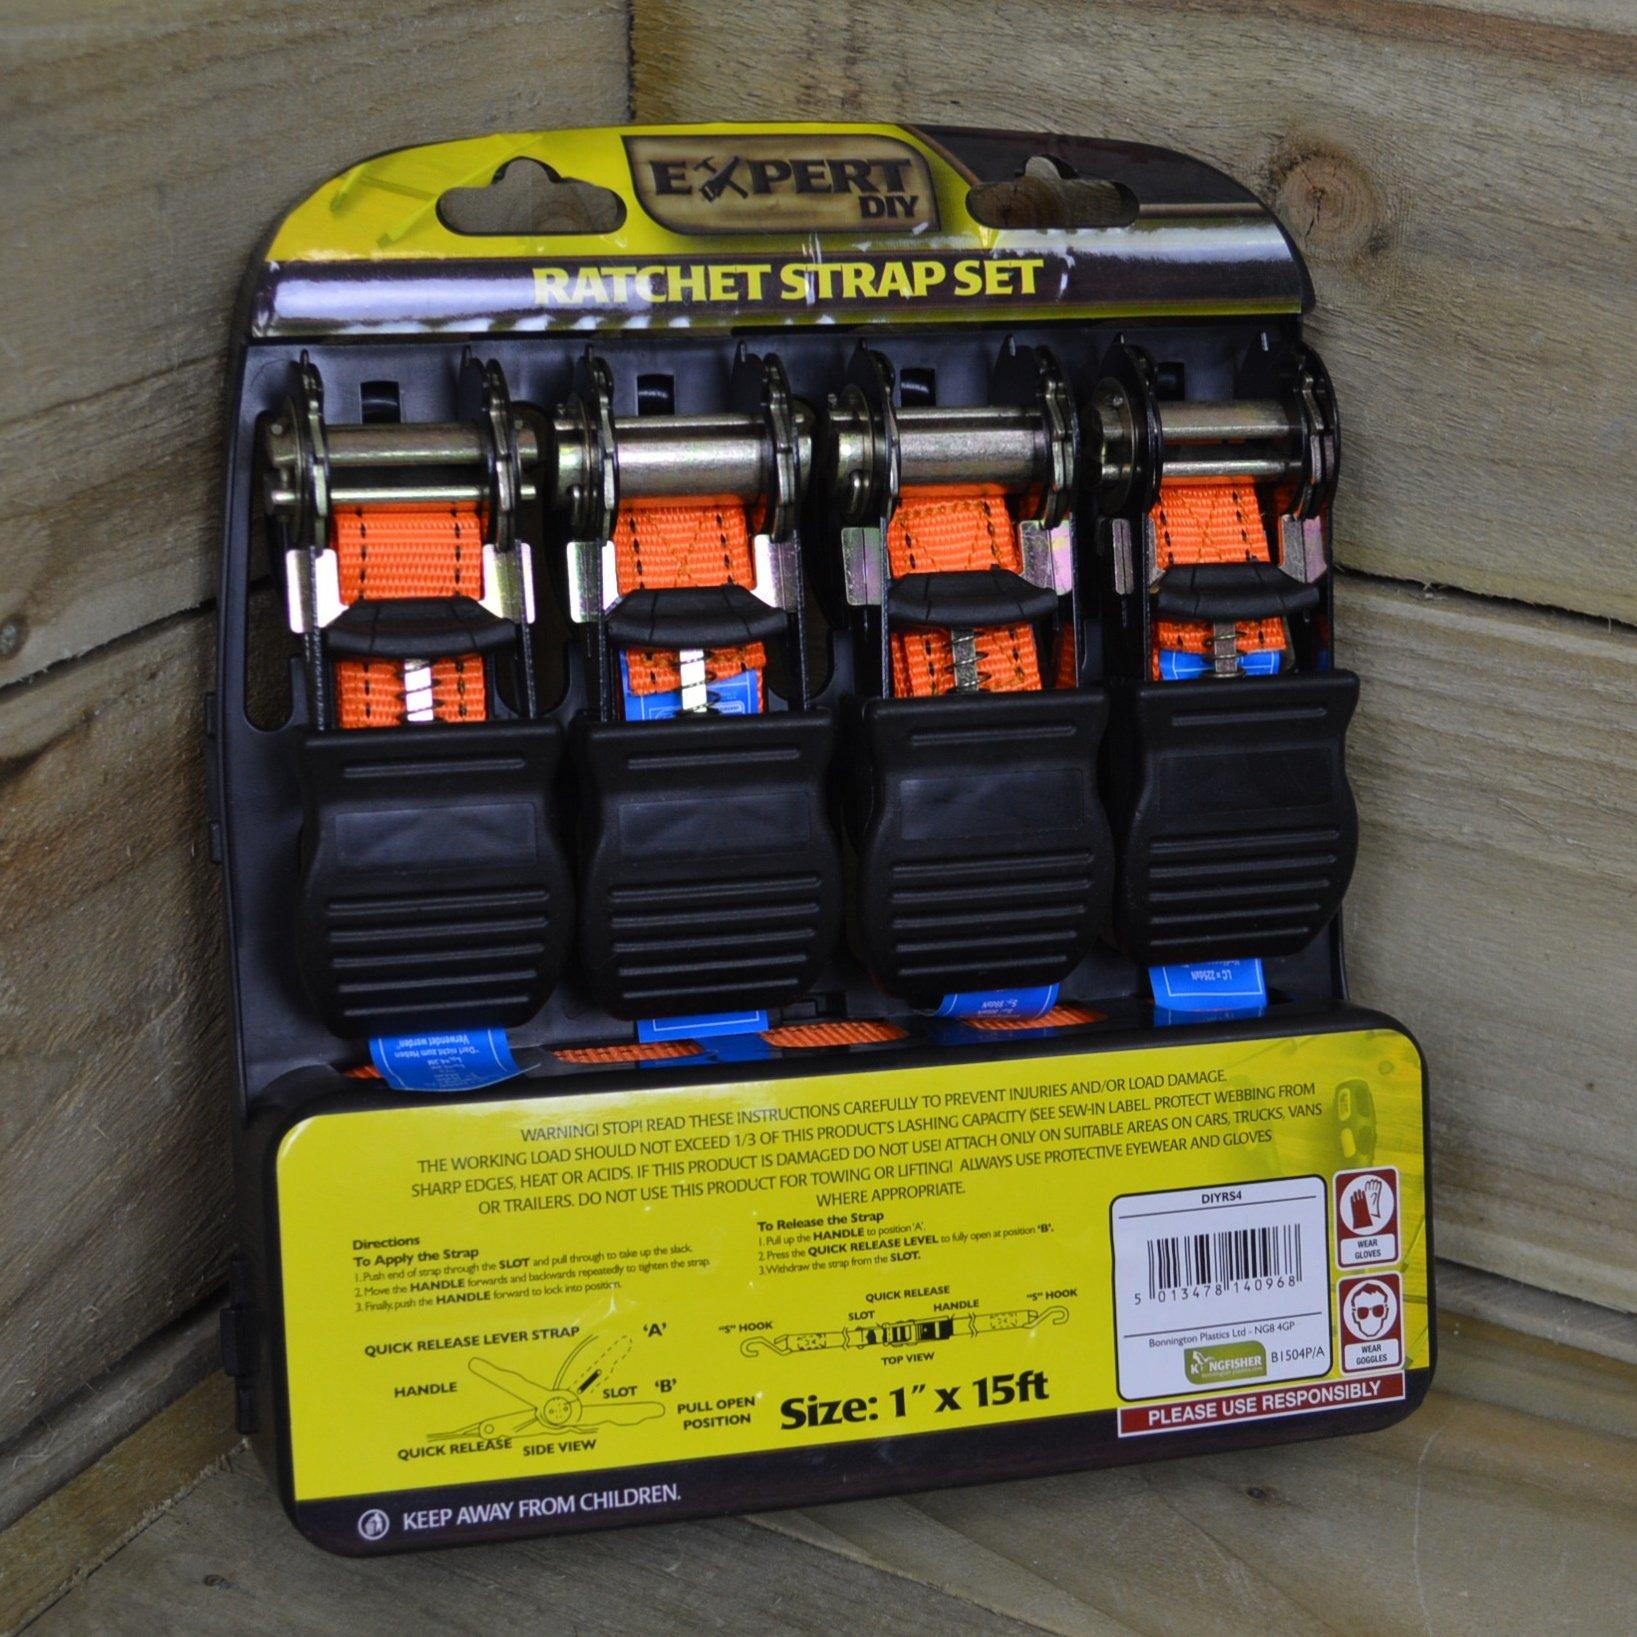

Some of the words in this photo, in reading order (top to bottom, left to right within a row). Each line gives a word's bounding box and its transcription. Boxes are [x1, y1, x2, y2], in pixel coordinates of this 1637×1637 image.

[649, 156, 913, 202] EXPERT
[859, 194, 918, 219] DIY
[534, 264, 772, 302] RATCHET
[780, 260, 946, 300] STRAP
[954, 259, 1044, 296] SET
[520, 1124, 598, 1142] WARNING!
[602, 1120, 642, 1135] STOP!
[647, 1116, 686, 1132] READ
[688, 1112, 734, 1128] THESE
[737, 1103, 840, 1124] INSTRUCTIONS
[844, 1096, 918, 1114] CAREFULLY
[945, 1089, 1007, 1106] PREVENT
[1010, 1084, 1067, 1100] INJURIES
[1070, 1079, 1126, 1095] AND/OR
[1129, 1075, 1164, 1090] LOAD
[417, 1158, 447, 1173] THE
[451, 1152, 527, 1170] WORKING
[531, 1149, 571, 1164] LOAD
[575, 1143, 636, 1160] SHOULD
[640, 1140, 672, 1155] NOT
[675, 1136, 730, 1152] EXCEED
[735, 1133, 756, 1147] 1/3
[782, 1128, 814, 1143] THIS
[898, 1115, 958, 1132] LASHING
[962, 1109, 1026, 1127] CAPACITY
[1030, 1107, 1056, 1122] (SEE
[1058, 1102, 1105, 1118] SEW-IN
[1154, 1092, 1212, 1109] PROTECT
[1214, 1086, 1275, 1104] WEBBING
[1279, 1083, 1315, 1098] FROM
[412, 1181, 461, 1197] SHARP
[465, 1176, 516, 1192] EDGES,
[520, 1172, 558, 1188] HEAT
[587, 1166, 633, 1182] ACIDS.
[652, 1162, 684, 1176] THIS
[688, 1155, 758, 1173] PRODUCT
[777, 1148, 850, 1166] DAMAGED
[879, 1142, 909, 1156] NOT
[912, 1139, 941, 1154] USE!
[945, 1134, 997, 1151] ATTACH
[1000, 1130, 1036, 1145] ONLY
[1064, 1122, 1124, 1140] SUITABLE
[1127, 1118, 1168, 1134] AREAS
[1195, 1112, 1230, 1127] CARS,
[1233, 1107, 1285, 1123] TRUCKS,
[1288, 1103, 1322, 1118] VANS
[504, 1194, 574, 1212] TRAILERS.
[606, 1188, 637, 1204] NOT
[641, 1186, 668, 1200] USE
[671, 1183, 704, 1198] THIS
[707, 1176, 776, 1194] PRODUCT
[780, 1174, 808, 1188] FOR
[810, 1168, 870, 1185] TOWING
[898, 1160, 952, 1177] LIFTING!
[960, 1154, 1013, 1172] ALWAYS
[1016, 1152, 1041, 1166] USE
[1045, 1144, 1123, 1164] PROTECTIVE
[1126, 1138, 1187, 1156] EYEWEAR
[1190, 1135, 1220, 1149] AND
[1223, 1129, 1272, 1146] GLOVES
[816, 1190, 868, 1207] WHERE
[1202, 1190, 1242, 1204] DIYRS4
[757, 1222, 773, 1232] To
[777, 1218, 824, 1230] Release
[827, 1215, 847, 1225] the
[851, 1213, 884, 1223] Strap
[813, 1228, 864, 1241] HANDLE
[353, 1237, 420, 1250] Directions
[808, 1244, 847, 1257] QUICK
[850, 1238, 900, 1251] RELEASE
[904, 1235, 938, 1246] LEVEL
[1358, 1239, 1378, 1248] WEAR
[353, 1257, 370, 1267] To
[374, 1253, 414, 1267] Apply
[418, 1252, 440, 1262] the
[443, 1249, 479, 1260] Strap
[890, 1250, 920, 1262] SLOT.
[1355, 1249, 1381, 1260] GLOVES
[499, 1257, 530, 1270] SLOT
[410, 1278, 464, 1292] HANDLE
[436, 1291, 490, 1304] HANDLE
[866, 1290, 901, 1303] QUICK
[904, 1286, 950, 1298] RELEASE
[1046, 1289, 1078, 1299] HOOK
[934, 1299, 978, 1312] HANDLE
[848, 1310, 875, 1321] SLOT
[739, 1321, 772, 1332] HOOK
[1149, 1336, 1197, 1348] Bonnington
[1200, 1332, 1230, 1341] Plastics
[1232, 1328, 1246, 1337] Ltd
[1255, 1324, 1275, 1334] NG8
[1277, 1321, 1295, 1331] 4GP
[365, 1342, 412, 1358] QUICK
[417, 1336, 479, 1351] RELEASE
[484, 1331, 528, 1345] LEVER
[532, 1326, 580, 1340] STRAP
[1362, 1344, 1382, 1355] WEAR
[881, 1356, 903, 1365] TOP
[906, 1352, 934, 1362] VIEW
[1272, 1346, 1324, 1362] B1504P/A
[1356, 1355, 1387, 1366] GOGGLES
[394, 1382, 457, 1398] HANDLE
[603, 1386, 637, 1399] SLOT
[678, 1402, 713, 1414] PULL
[716, 1396, 755, 1410] OPEN
[780, 1395, 878, 1430] Size:
[935, 1387, 961, 1412] x
[973, 1370, 1049, 1407] 15ft
[1149, 1402, 1217, 1426] PLEASE
[1222, 1397, 1257, 1416] USE
[1262, 1380, 1380, 1410] RESPONSIBLY
[684, 1414, 750, 1430] POSITION
[398, 1445, 446, 1461] QUICK
[450, 1437, 514, 1454] RELEASE
[523, 1444, 554, 1456] SIDE
[558, 1439, 596, 1452] VIEW
[404, 1509, 452, 1530] KEEP
[456, 1502, 514, 1524] AWAY
[519, 1495, 575, 1518] FROM
[580, 1484, 681, 1510] CHILDREN.
